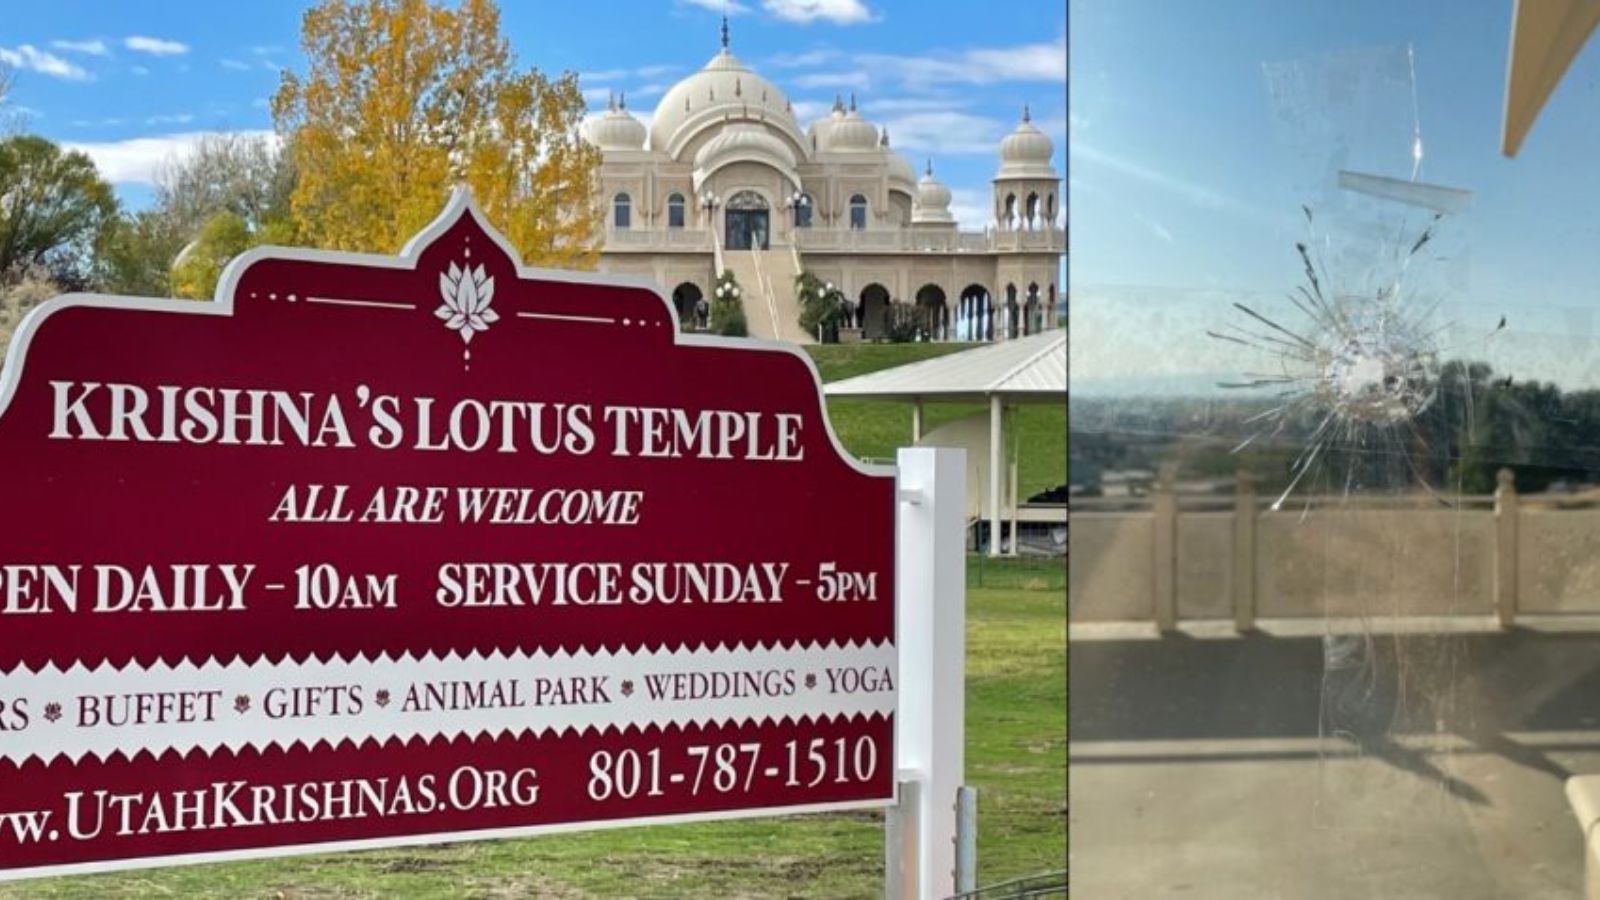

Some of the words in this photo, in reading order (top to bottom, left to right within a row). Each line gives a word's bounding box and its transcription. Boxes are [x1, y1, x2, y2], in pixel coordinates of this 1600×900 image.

[49, 380, 402, 448] KRISHNA'S
[413, 397, 595, 454] LOTUS
[603, 406, 804, 461] TEMPLE
[268, 484, 355, 522] ALL
[358, 487, 448, 523] ARE
[456, 488, 643, 524] WELCOME
[0, 565, 82, 614] EN
[93, 564, 256, 612] DAILY
[294, 563, 398, 609] 10AM
[436, 562, 623, 607] SERVICE
[629, 562, 789, 603] SUNDAY
[816, 562, 877, 602] 5PM
[76, 690, 223, 728] BUFFET
[263, 685, 364, 718] GIFTS
[401, 678, 525, 713] ANIMAL
[534, 675, 611, 706] PARK
[643, 669, 796, 701] WEDDINGS
[826, 666, 894, 694] YOGA
[588, 735, 877, 800] 801-787-1510
